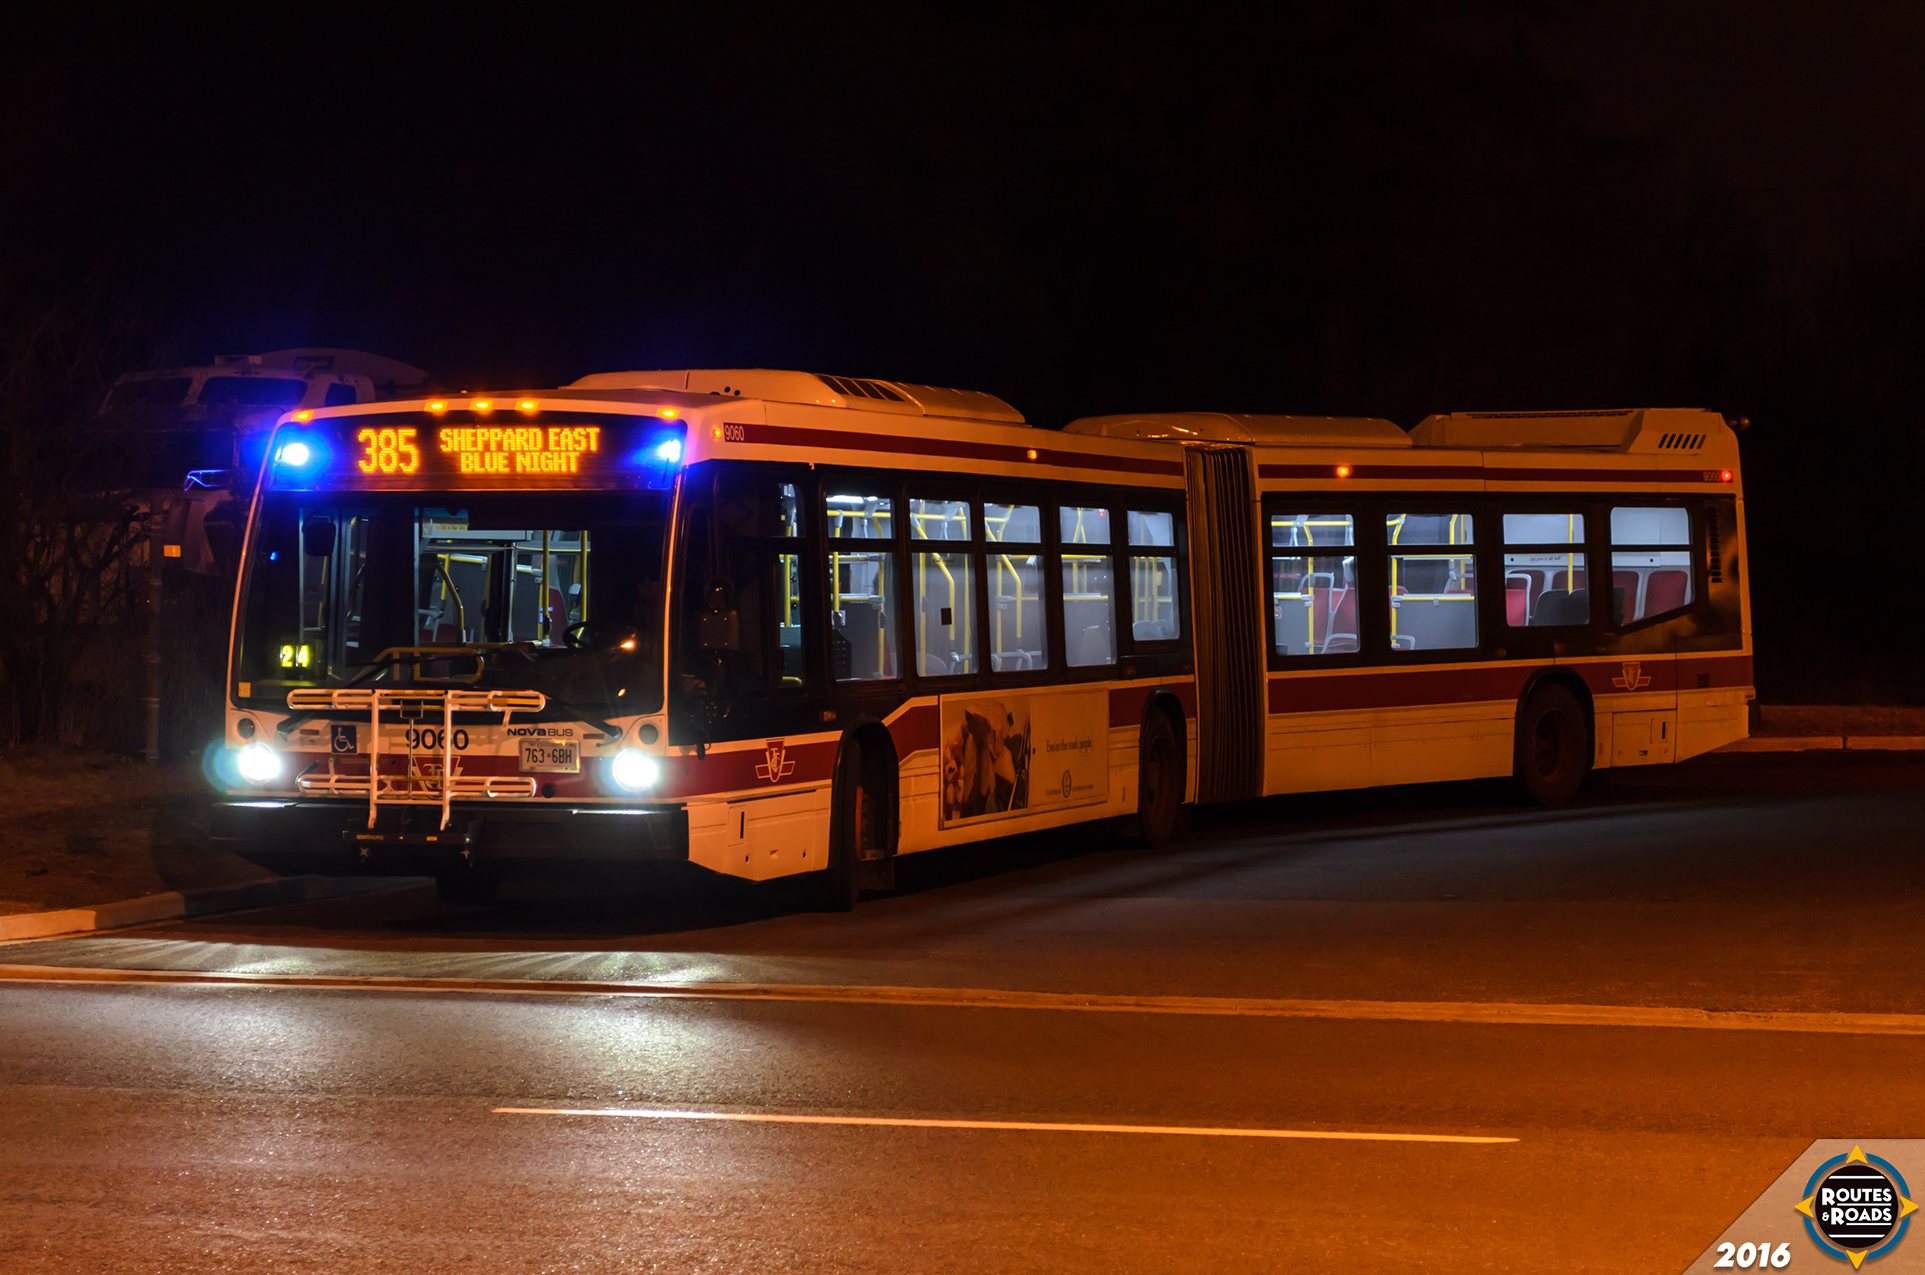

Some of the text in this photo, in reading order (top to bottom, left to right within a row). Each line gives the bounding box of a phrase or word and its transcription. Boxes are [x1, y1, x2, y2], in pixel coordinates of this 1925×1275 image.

[440, 427, 600, 451] SHEPPARD EAST
[724, 424, 745, 441] 9060
[358, 429, 419, 473] 385
[460, 451, 580, 473] BLUE NIGHT
